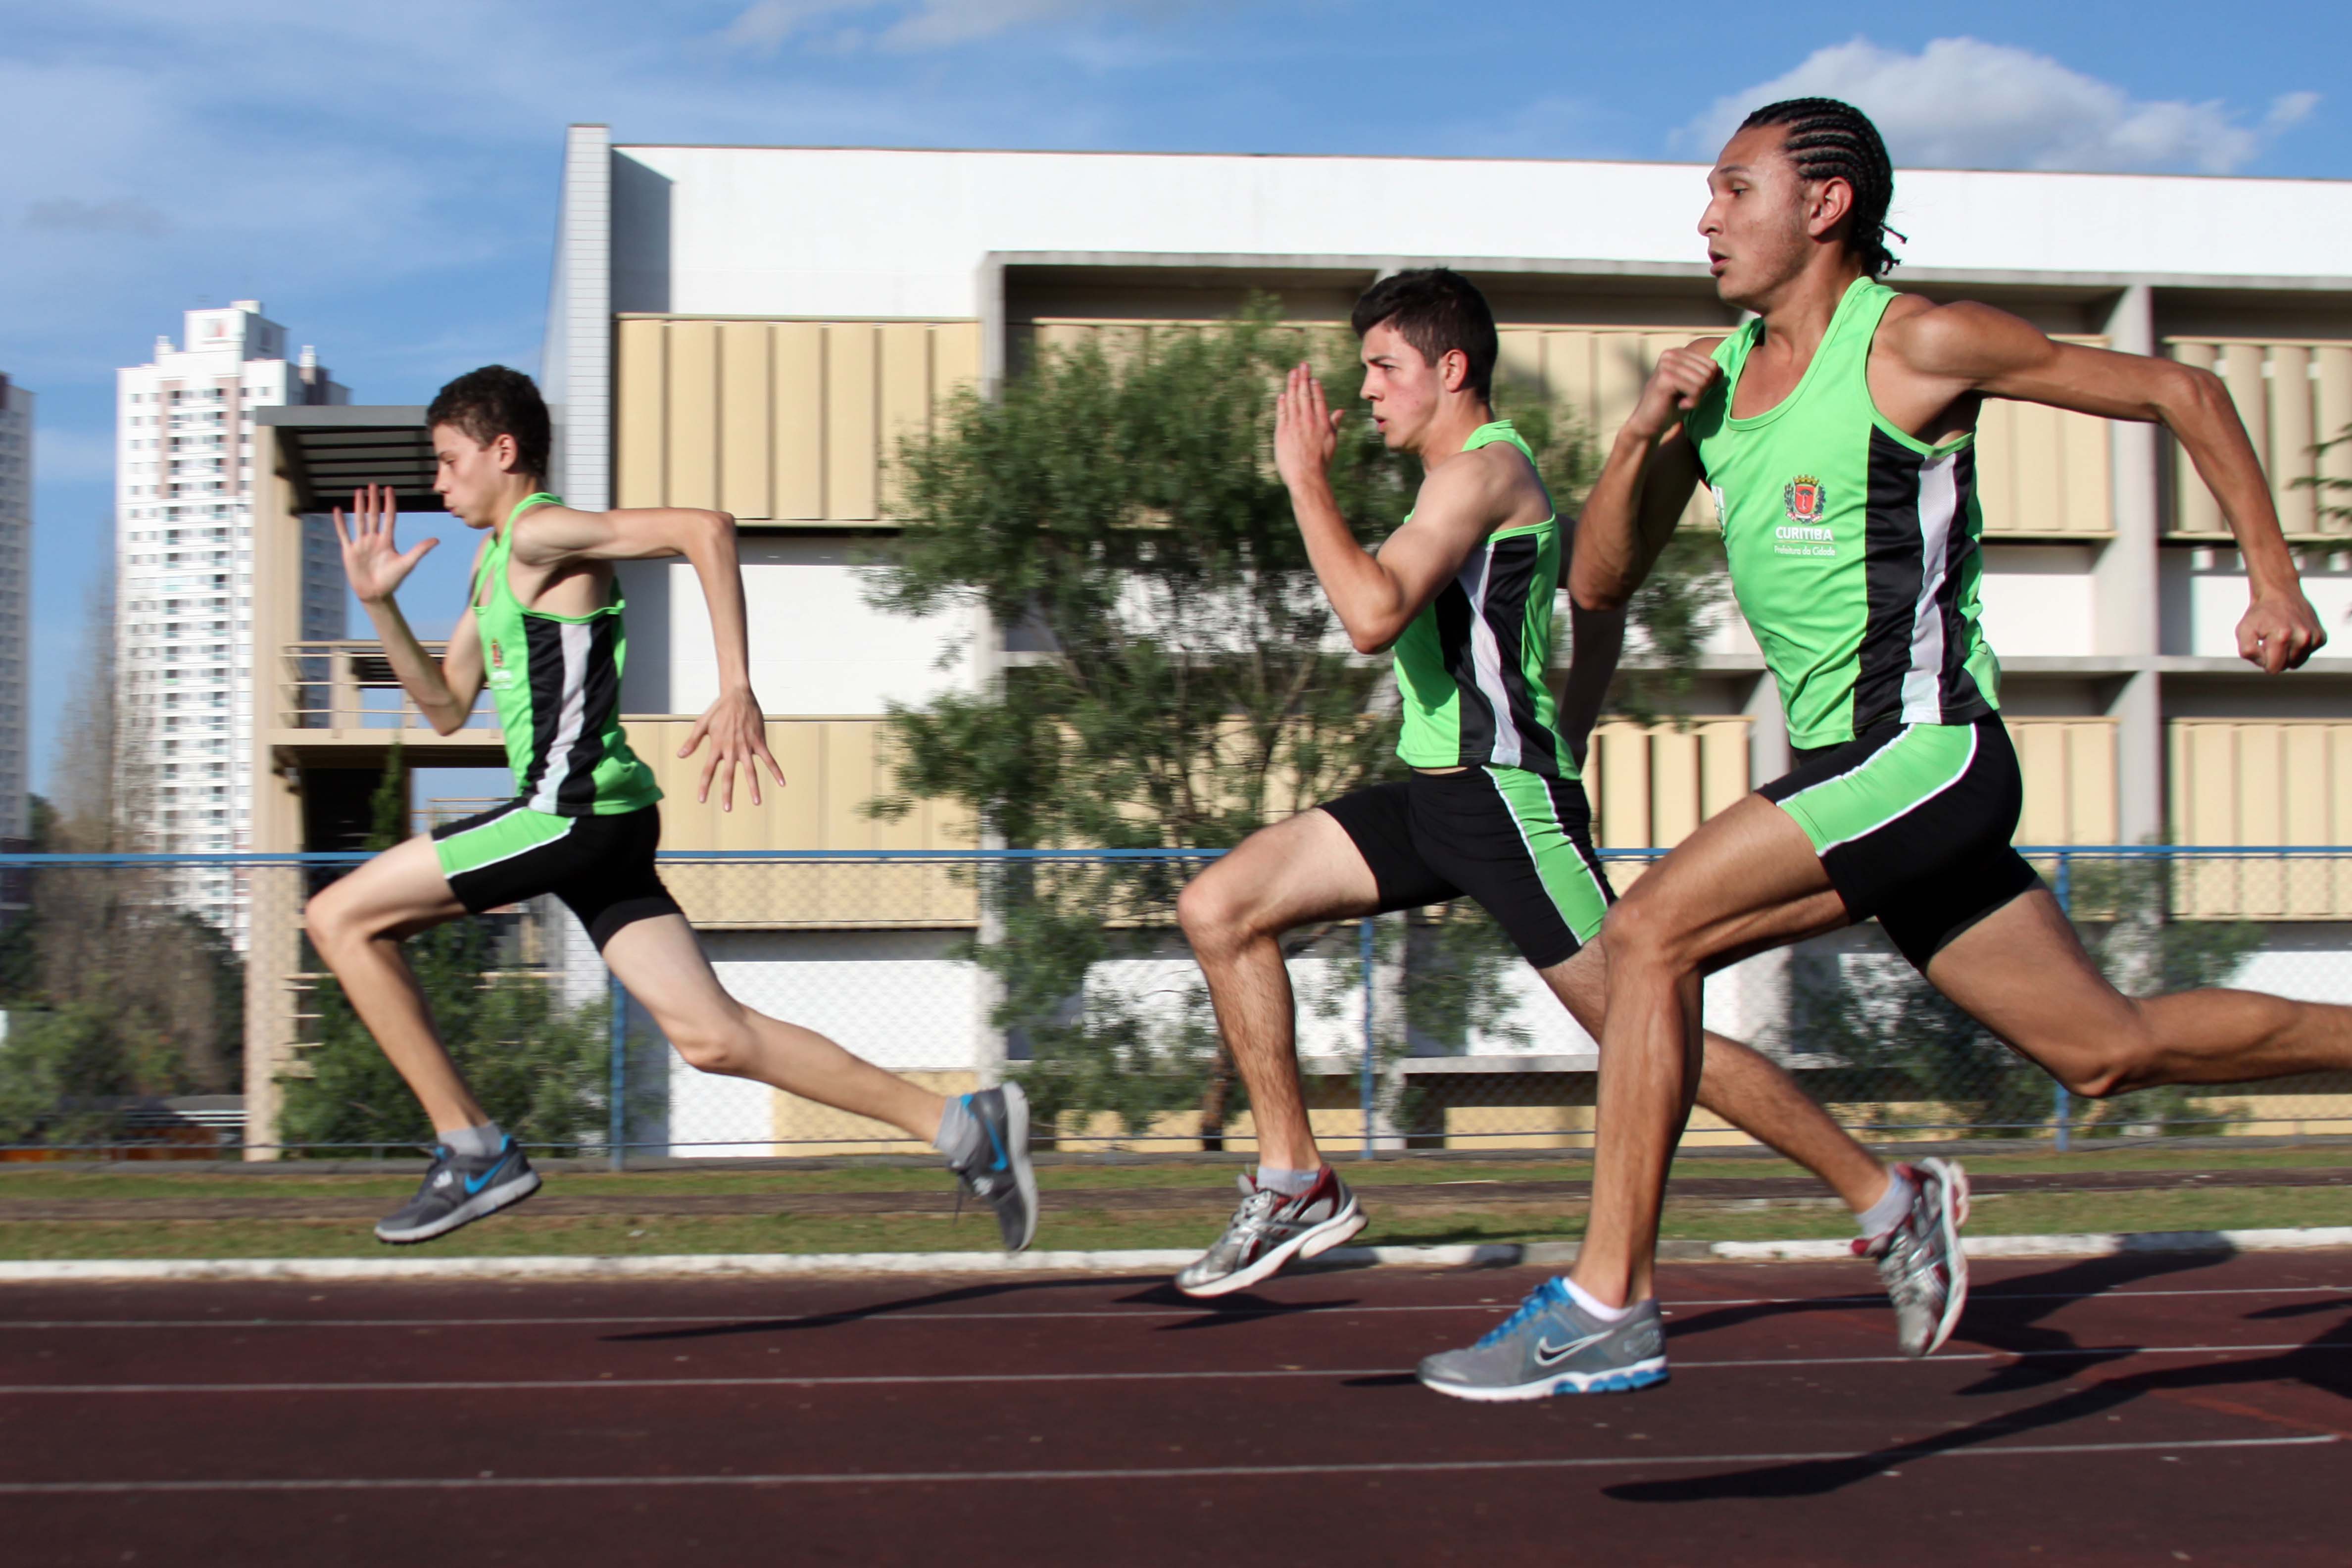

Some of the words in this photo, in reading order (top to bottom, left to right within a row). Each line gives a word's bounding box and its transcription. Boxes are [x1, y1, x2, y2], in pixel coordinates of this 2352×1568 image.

[1775, 527, 1833, 540] CURITIBA
[1774, 545, 1801, 555] Prefeitura
[1802, 546, 1811, 555] da
[1813, 546, 1835, 555] Cidade
